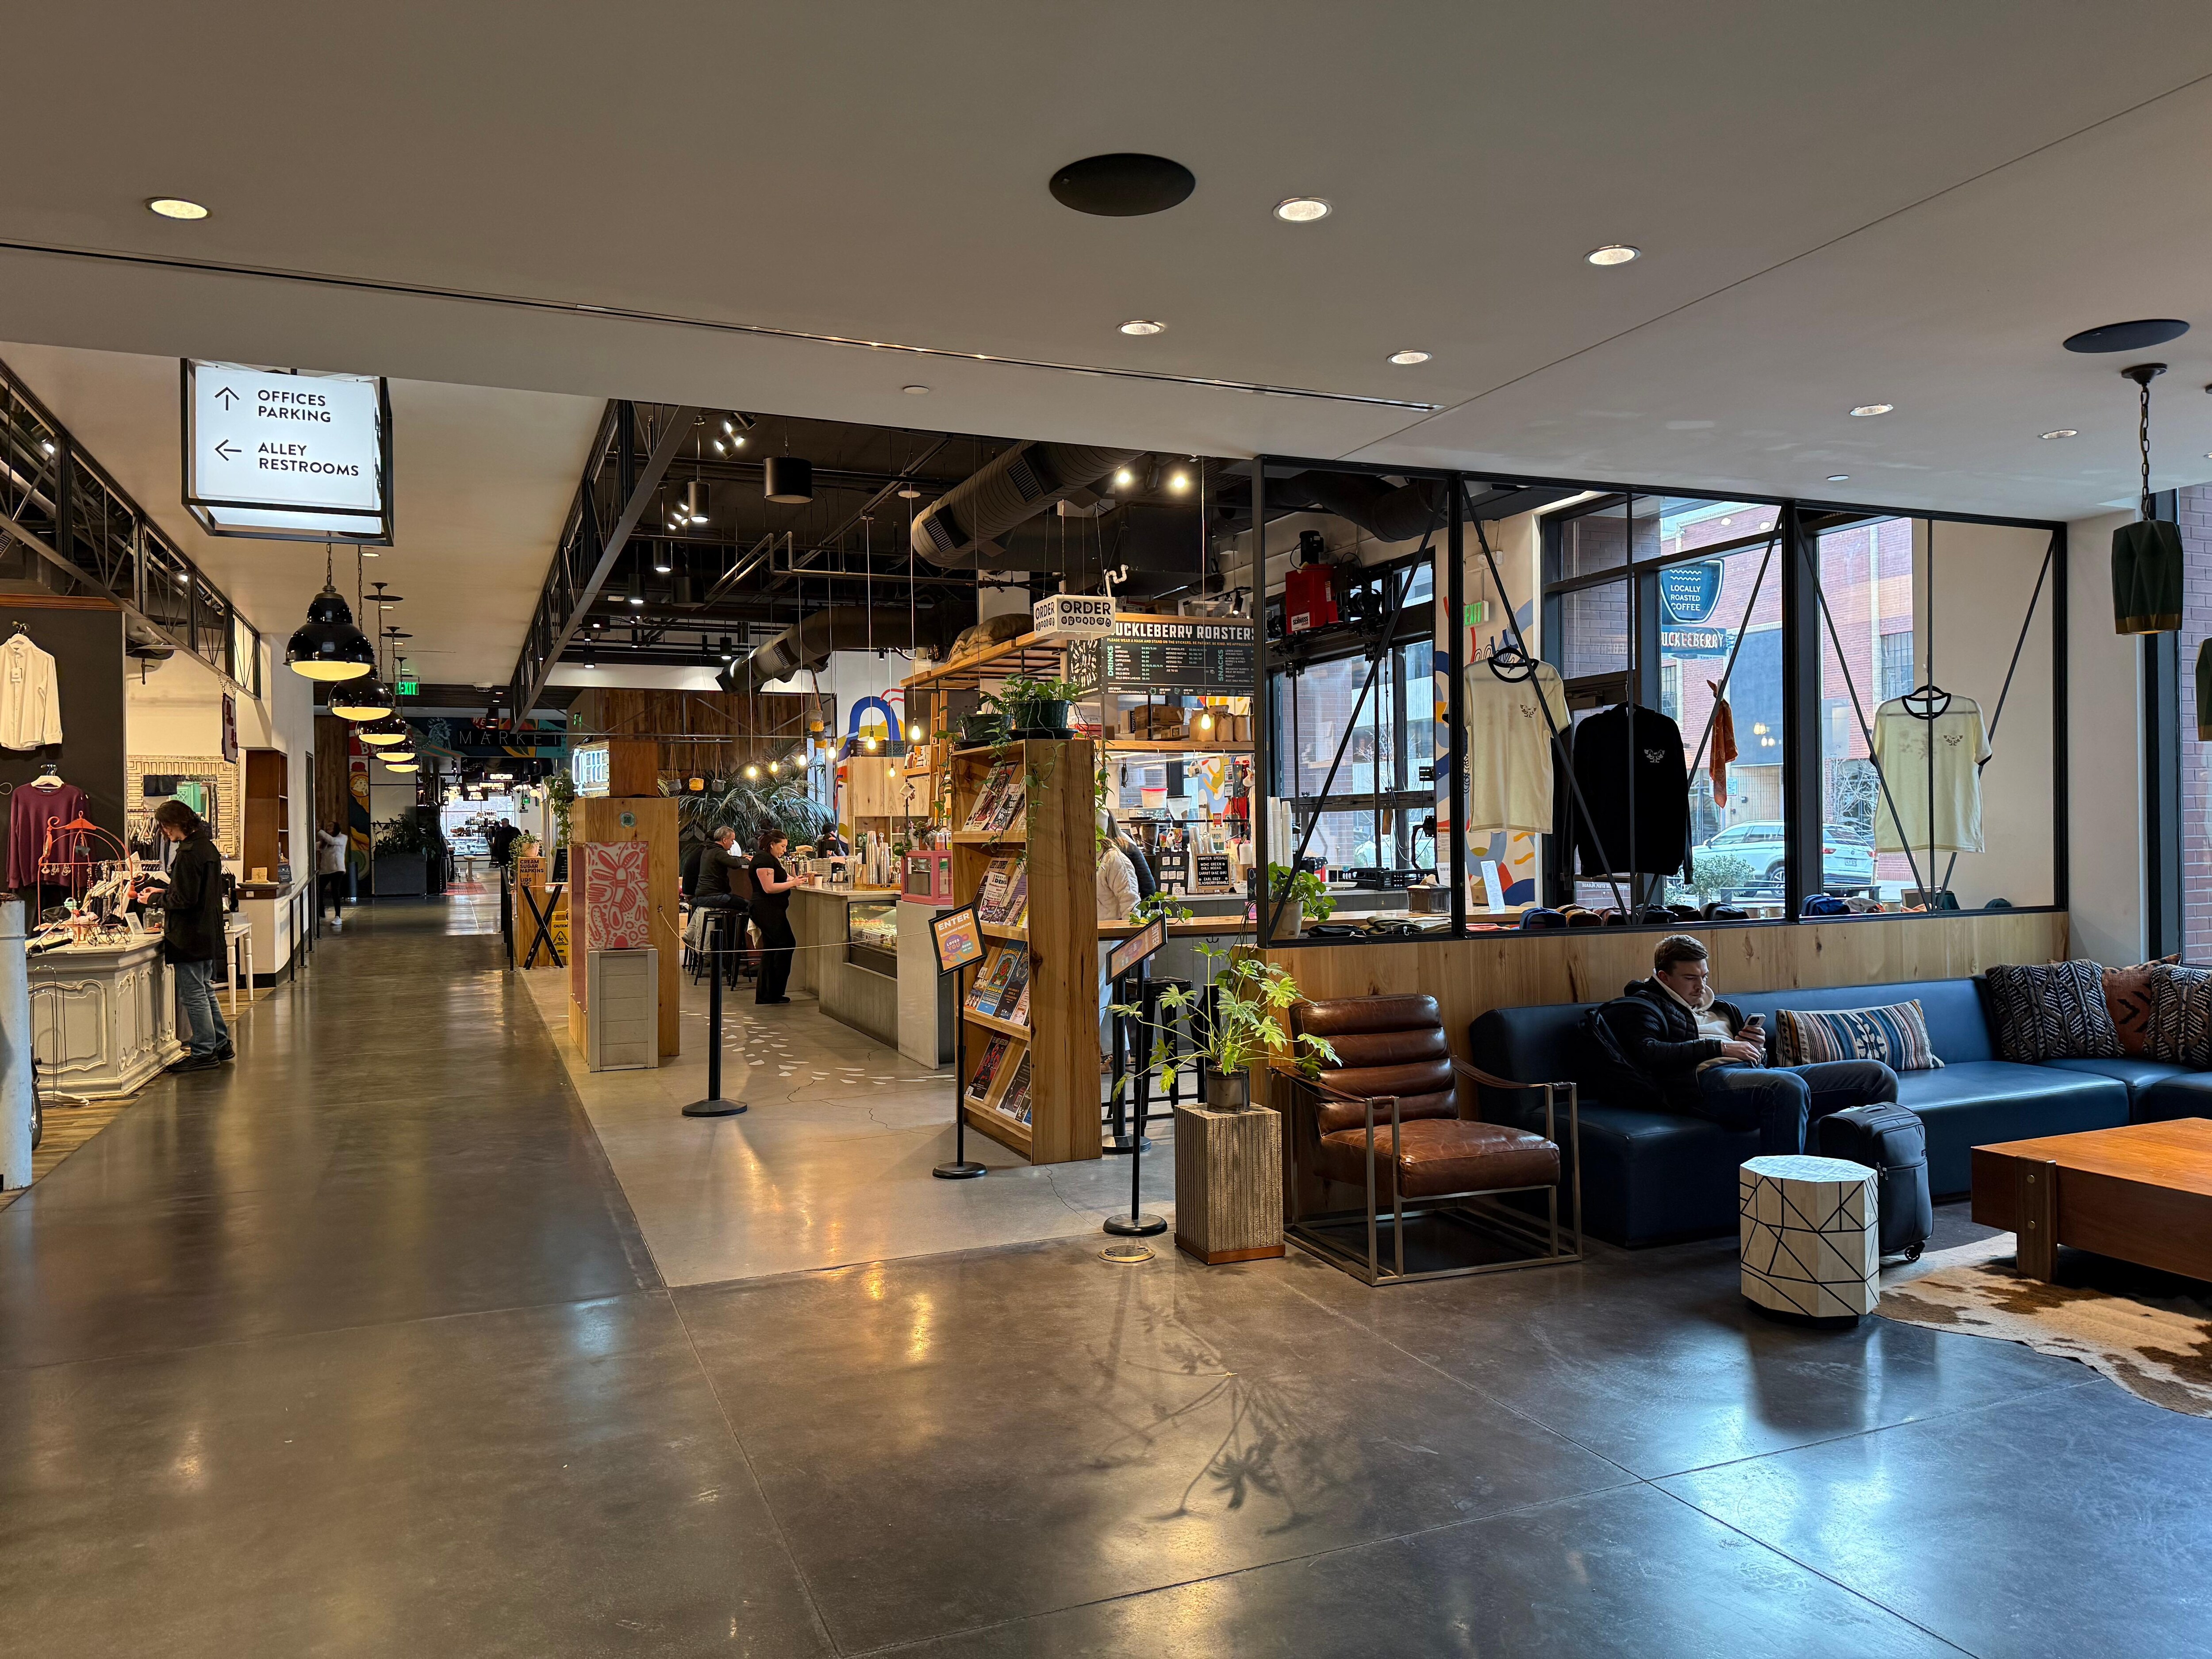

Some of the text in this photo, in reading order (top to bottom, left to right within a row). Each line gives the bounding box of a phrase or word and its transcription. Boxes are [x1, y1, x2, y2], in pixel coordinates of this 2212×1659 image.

[258, 390, 326, 407] OFFICES
[258, 406, 330, 422] PARKING
[258, 442, 307, 456] ALLEY
[259, 457, 359, 476] RESTROOMS
[1036, 602, 1055, 620] ORDER
[1061, 600, 1111, 615] ORDER
[1465, 602, 1482, 626] EXIT
[1113, 622, 1192, 638] UCKLEBERRY
[399, 682, 417, 695] EXIT
[460, 731, 557, 745] MARKET
[938, 913, 970, 931] ENTER
